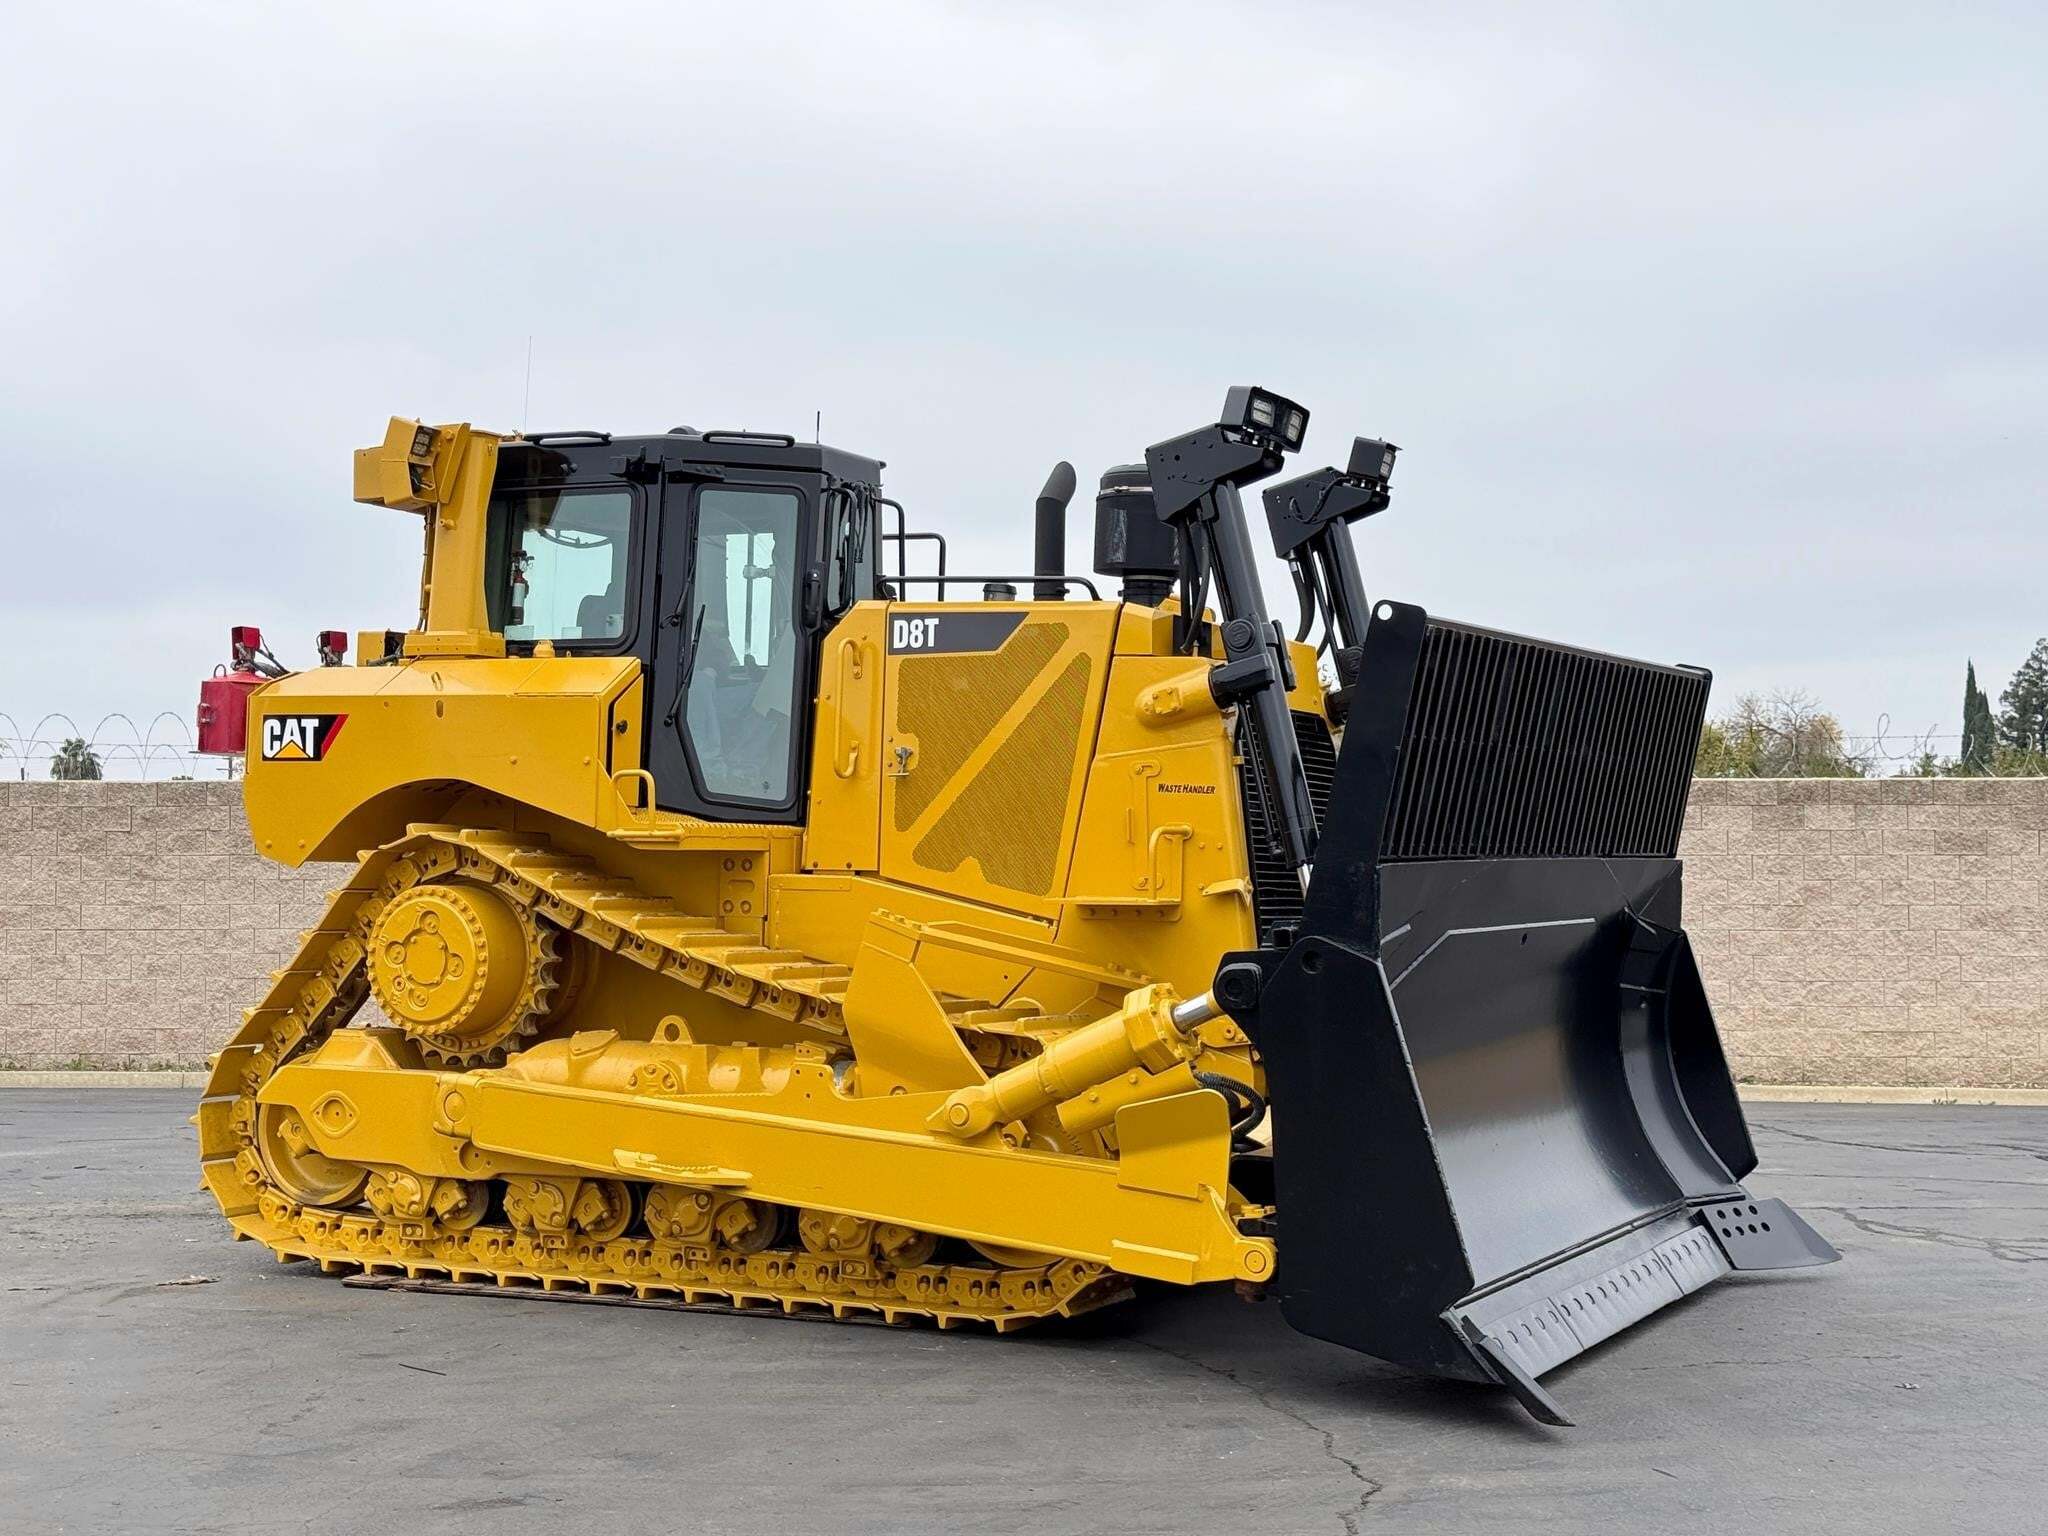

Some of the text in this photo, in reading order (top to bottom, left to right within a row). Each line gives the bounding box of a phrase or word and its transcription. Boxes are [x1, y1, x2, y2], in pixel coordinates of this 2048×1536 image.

[893, 617, 940, 649] D8T
[263, 718, 320, 759] CAT
[1158, 783, 1216, 795] WASTE HANDLER
